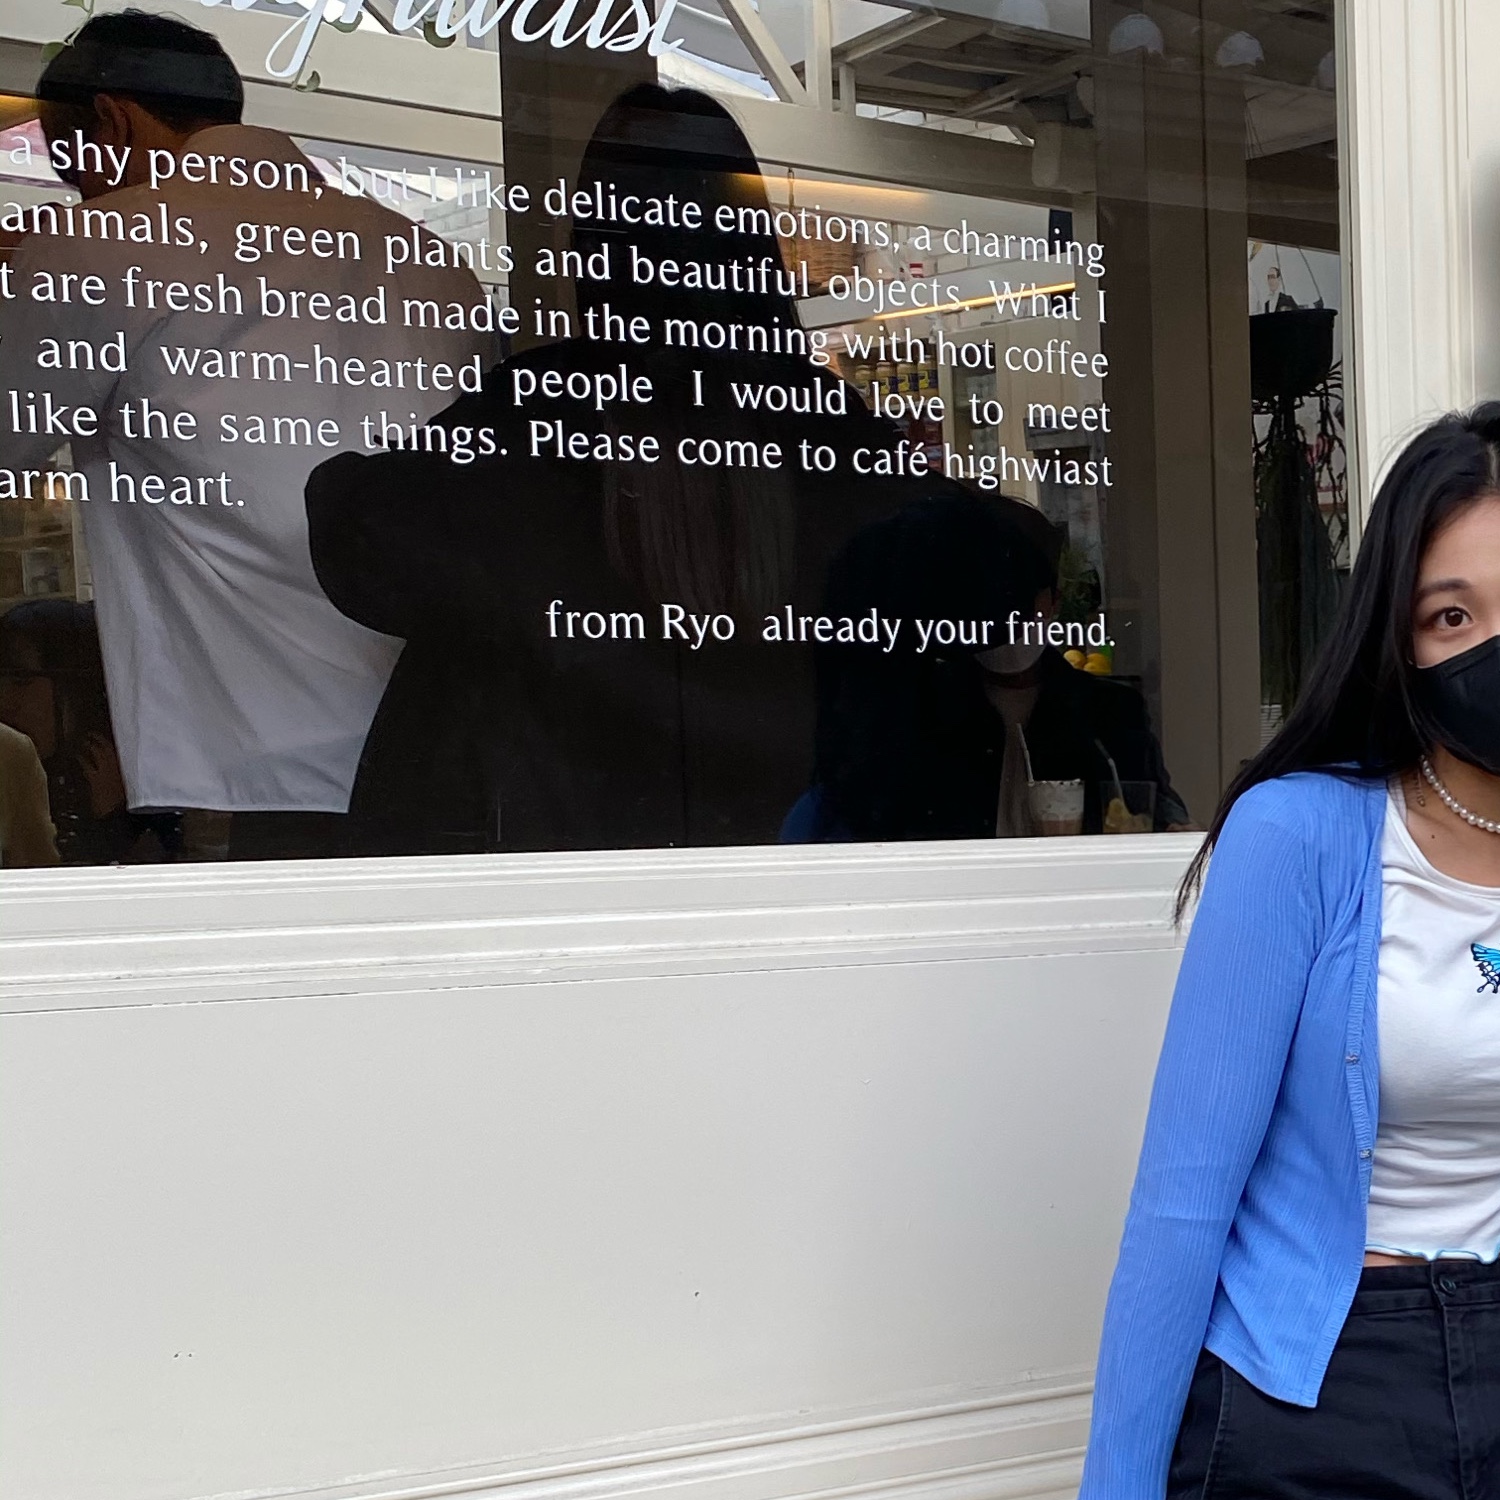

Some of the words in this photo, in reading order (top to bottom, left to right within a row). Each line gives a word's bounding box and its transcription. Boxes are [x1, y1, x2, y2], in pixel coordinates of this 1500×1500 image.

[10, 136, 31, 163] a
[50, 130, 131, 186] shy
[147, 150, 327, 197] person,
[339, 157, 413, 199] but
[428, 167, 437, 202] I
[455, 168, 530, 212] like
[544, 178, 702, 229] delicate
[715, 205, 903, 253] emotions,
[911, 226, 931, 251] a
[944, 220, 1105, 277] charming
[0, 196, 208, 254] animals,
[235, 223, 361, 262] green
[384, 225, 514, 273] plants
[535, 243, 611, 280] and
[629, 245, 810, 297] beautiful
[827, 265, 973, 312] objects.
[988, 280, 1081, 320] What
[1097, 290, 1106, 323] I
[32, 272, 106, 305] are
[121, 266, 243, 315] fresh
[258, 277, 387, 324] bread
[402, 293, 519, 334] made
[534, 301, 571, 338] in
[584, 305, 650, 343] the
[664, 316, 832, 366] morning
[843, 325, 926, 365] with
[937, 331, 995, 370] hot
[1005, 339, 1108, 377] coffee
[37, 331, 128, 372] and
[160, 344, 483, 392] warm-hearted
[512, 364, 653, 410] people
[692, 370, 704, 406] I
[730, 377, 847, 415] would
[872, 381, 947, 422] love
[968, 393, 1003, 425] to
[1028, 403, 1111, 433] meet
[0, 469, 90, 501] arm
[109, 461, 244, 506] heart.
[9, 390, 97, 436] like
[119, 398, 197, 440] the
[220, 415, 339, 447] same
[359, 411, 507, 463] things.
[529, 419, 659, 462] Please
[677, 438, 782, 469] come
[800, 439, 836, 471] to
[852, 439, 930, 477] café
[943, 441, 1113, 490] highwiast
[545, 600, 646, 639] from
[661, 604, 735, 650] Ryo
[762, 605, 902, 653] already
[915, 619, 993, 653] your
[1005, 611, 1115, 646] friend.
